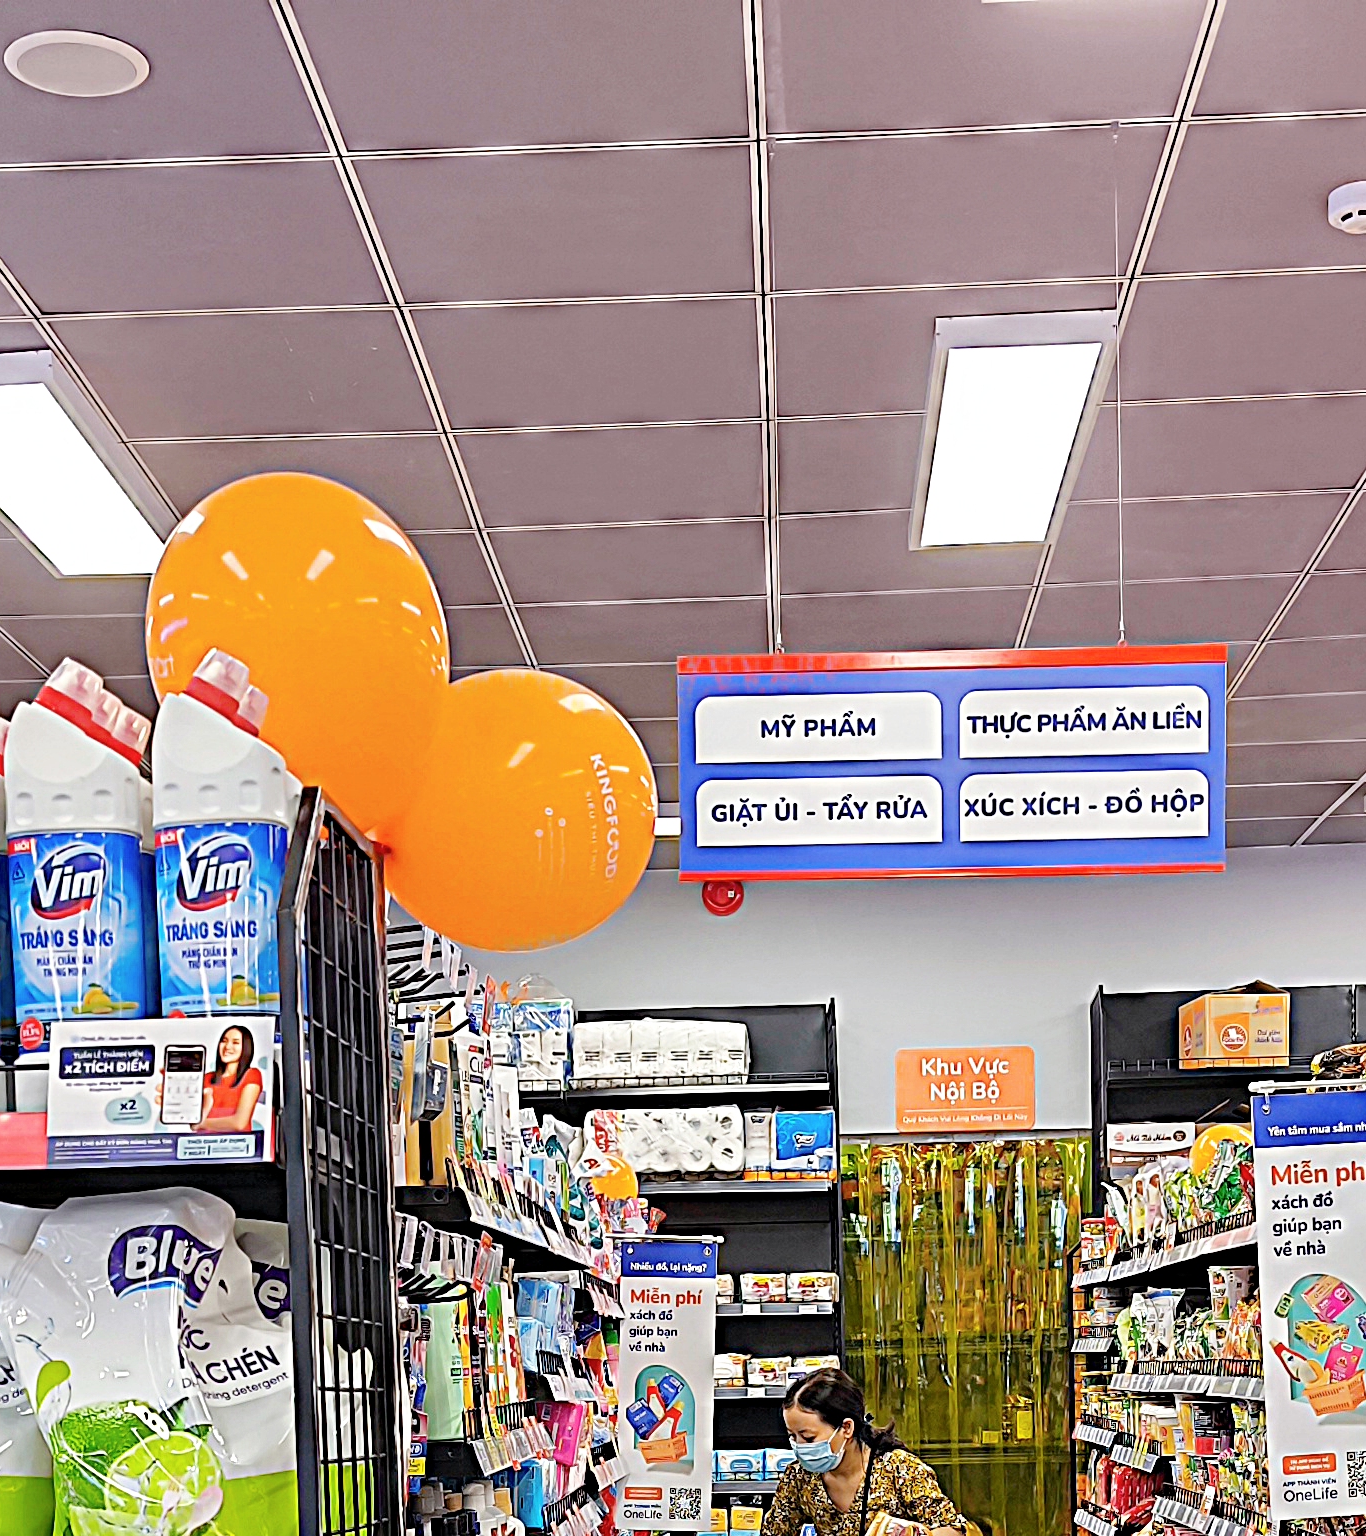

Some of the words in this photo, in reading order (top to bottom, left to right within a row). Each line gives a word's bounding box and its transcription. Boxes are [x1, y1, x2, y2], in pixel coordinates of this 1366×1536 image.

[760, 715, 795, 739] MỸ
[803, 712, 877, 738] PHẨM
[967, 712, 1031, 739] THỰC
[1038, 707, 1108, 733] PHẨM
[1113, 706, 1147, 731] ĂN
[1152, 703, 1203, 729] LIỀN
[711, 802, 768, 829] GIẶT
[774, 796, 799, 822] ỦI
[823, 793, 868, 820] TẨY
[875, 795, 929, 820] RỬA
[964, 791, 1014, 817] XÚC
[1022, 790, 1081, 816] XÍCH
[1104, 787, 1144, 814] ĐỒ
[1150, 791, 1206, 819] HỘP
[921, 1058, 961, 1076] Khu
[969, 1057, 1009, 1079] Vực
[930, 1082, 965, 1105] Nội
[973, 1080, 1000, 1104] Bộ
[1267, 1126, 1285, 1136] Yên
[1310, 1126, 1330, 1134] mua
[1333, 1122, 1353, 1133] sắm
[1271, 1160, 1328, 1186] Miễn
[1272, 1195, 1308, 1210] xách
[1313, 1191, 1333, 1207] đồ
[1273, 1218, 1307, 1236] giúp
[1312, 1217, 1341, 1234] bạn
[1274, 1241, 1292, 1256] về
[1297, 1240, 1326, 1255] nhà
[682, 1263, 707, 1273] nặng?
[631, 1287, 670, 1303] Miễn
[676, 1290, 702, 1307] phí
[630, 1310, 655, 1320] xách
[659, 1310, 672, 1320] đồ
[629, 1325, 653, 1337] giúp
[657, 1326, 677, 1338] bạn
[629, 1341, 641, 1351] về
[645, 1342, 665, 1352] nhà
[1284, 1487, 1338, 1502] OneLife
[624, 1510, 662, 1519] OneLife
